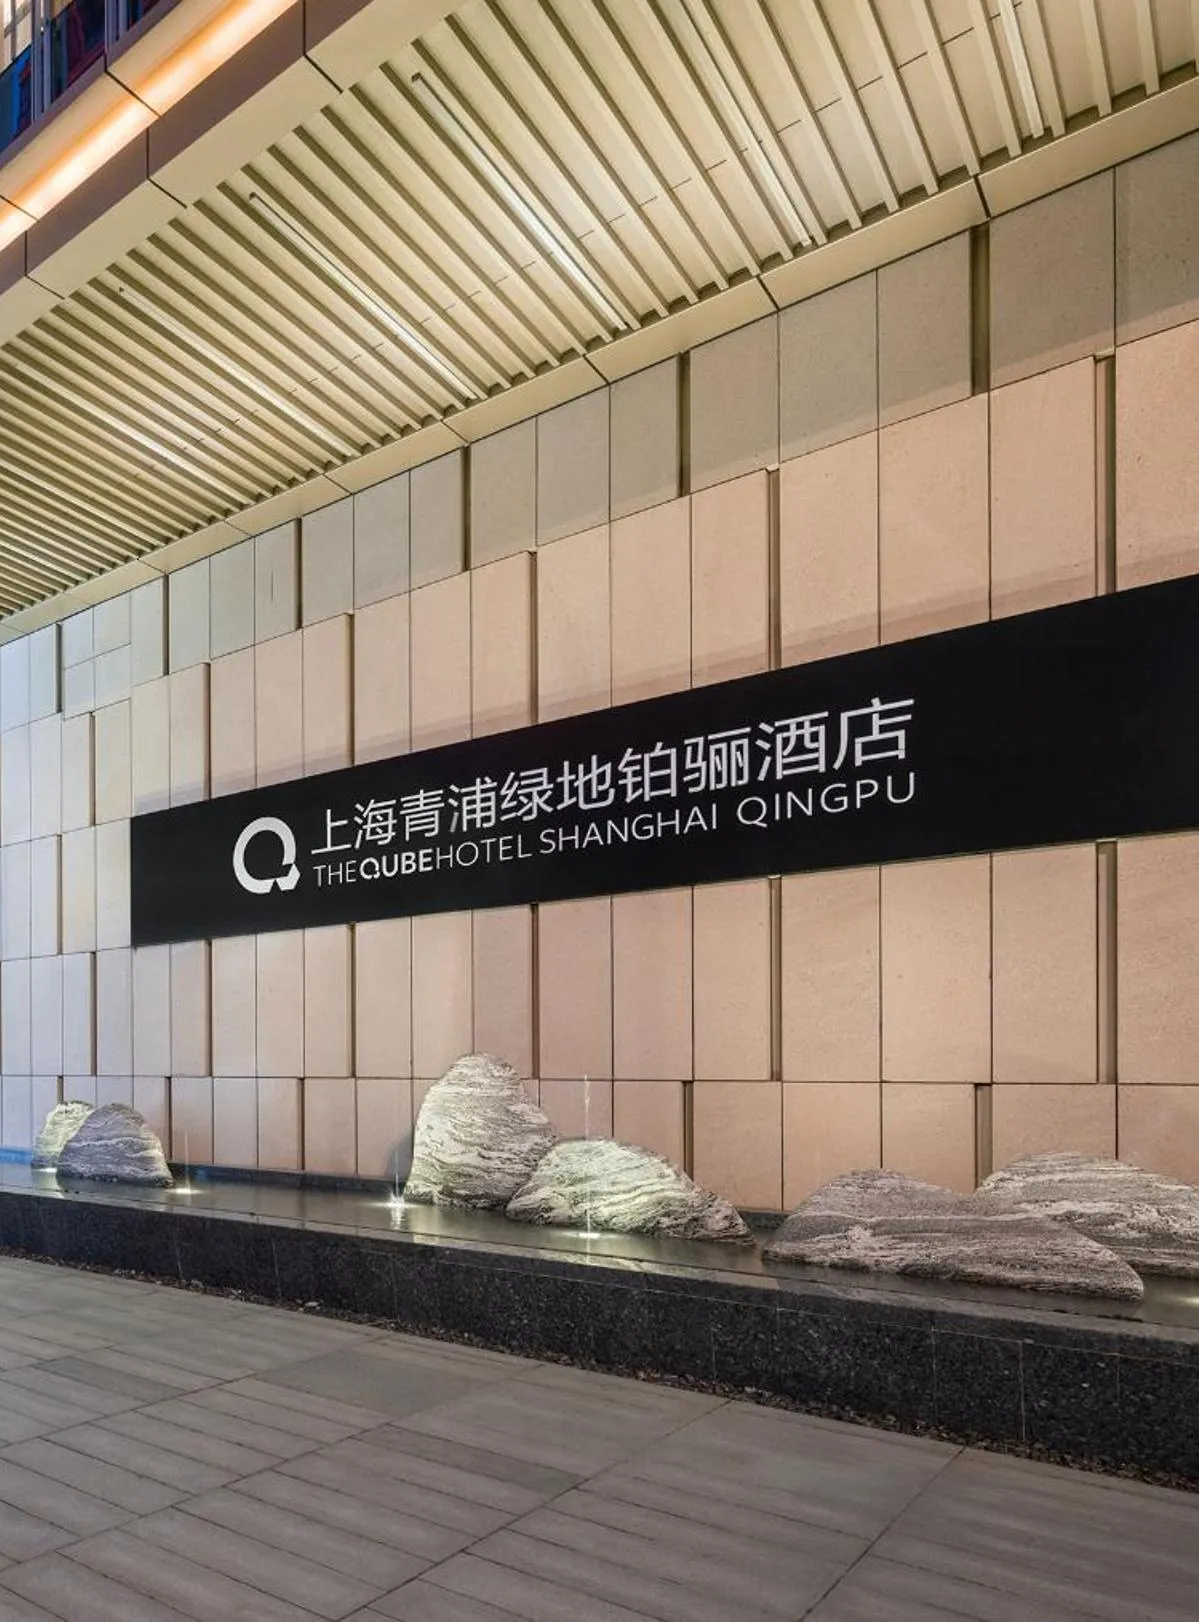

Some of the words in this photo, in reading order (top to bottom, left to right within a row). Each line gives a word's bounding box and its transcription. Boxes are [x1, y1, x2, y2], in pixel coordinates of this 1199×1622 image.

[310, 696, 915, 855] 上海青浦绿地铂骊酒店
[539, 803, 717, 854] SHANGHAI
[736, 771, 915, 828] QINGPU
